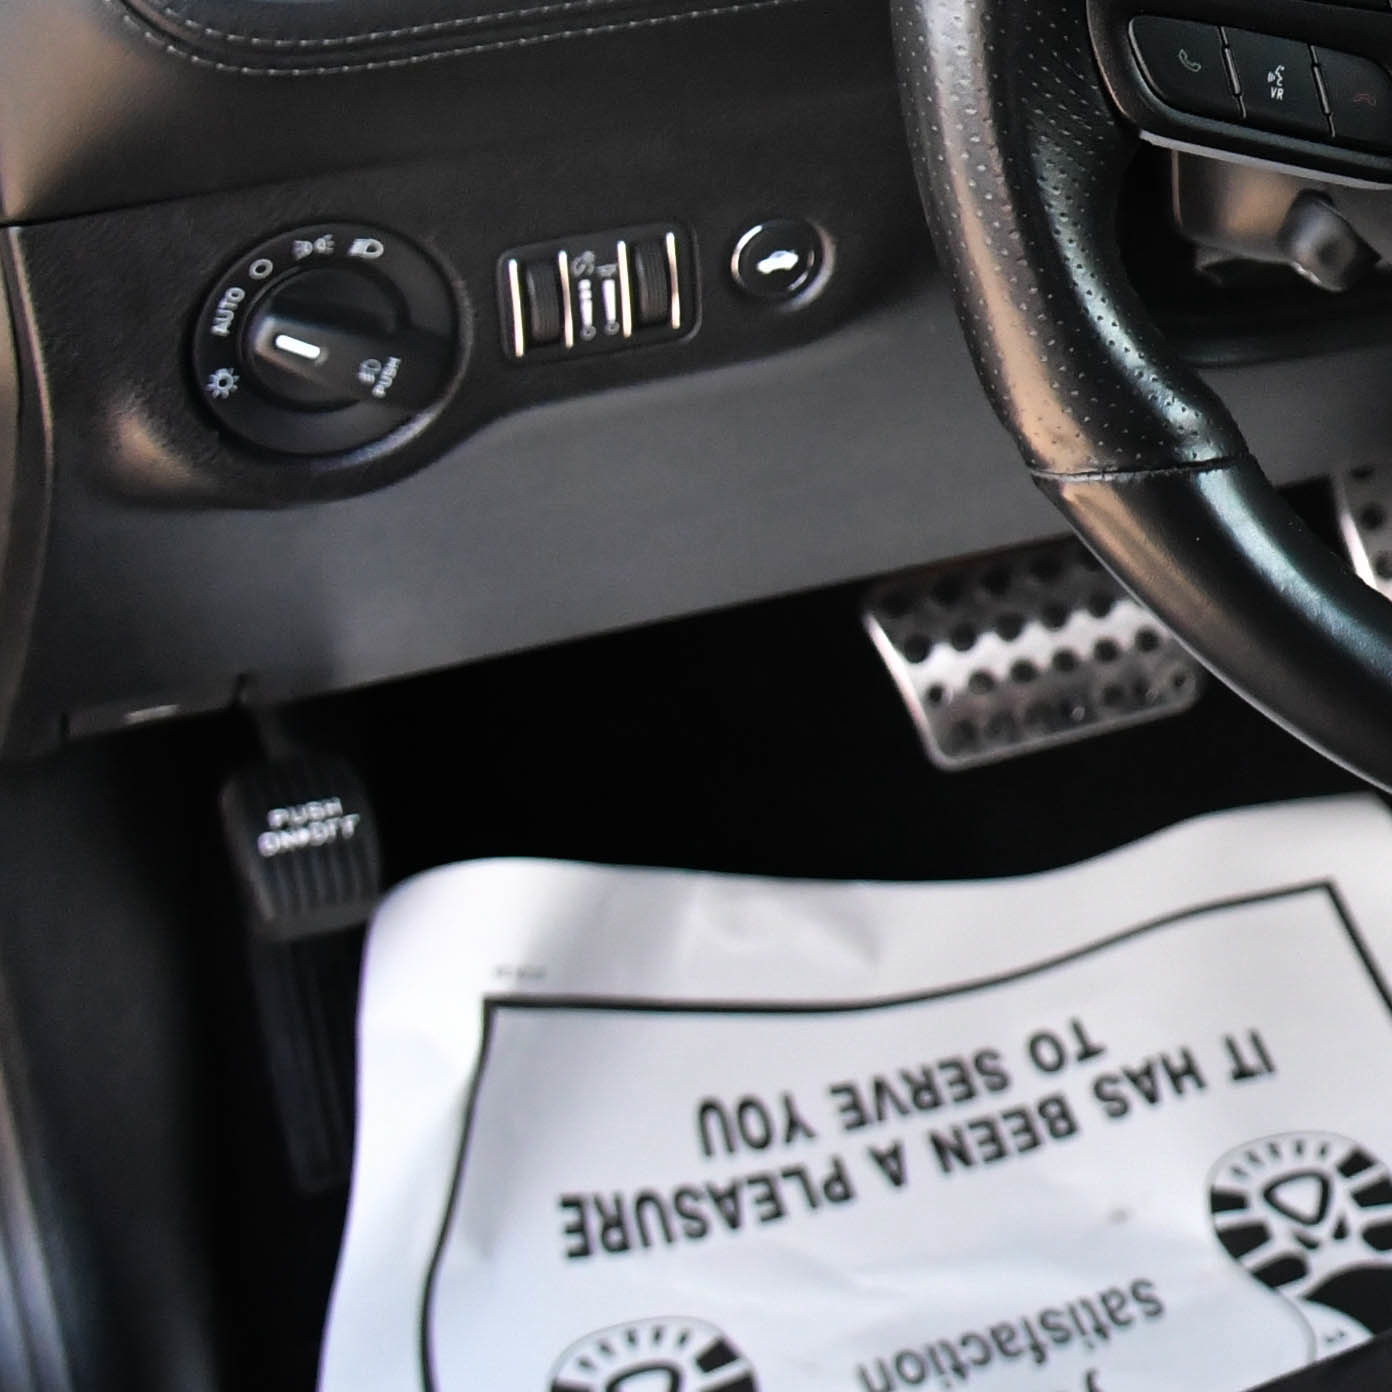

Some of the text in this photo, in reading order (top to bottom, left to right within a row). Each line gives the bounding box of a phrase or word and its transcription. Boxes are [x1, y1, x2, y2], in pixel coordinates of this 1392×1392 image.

[1270, 87, 1284, 101] VR
[211, 287, 246, 337] AUTO
[257, 813, 360, 857] ON/OFF
[267, 797, 343, 829] PUSH
[697, 1015, 1107, 1158] TO SERVE YOU
[559, 1027, 1277, 1260] IT HAS BEEN A PLEASURE
[855, 1277, 1167, 1392] satisfaction
